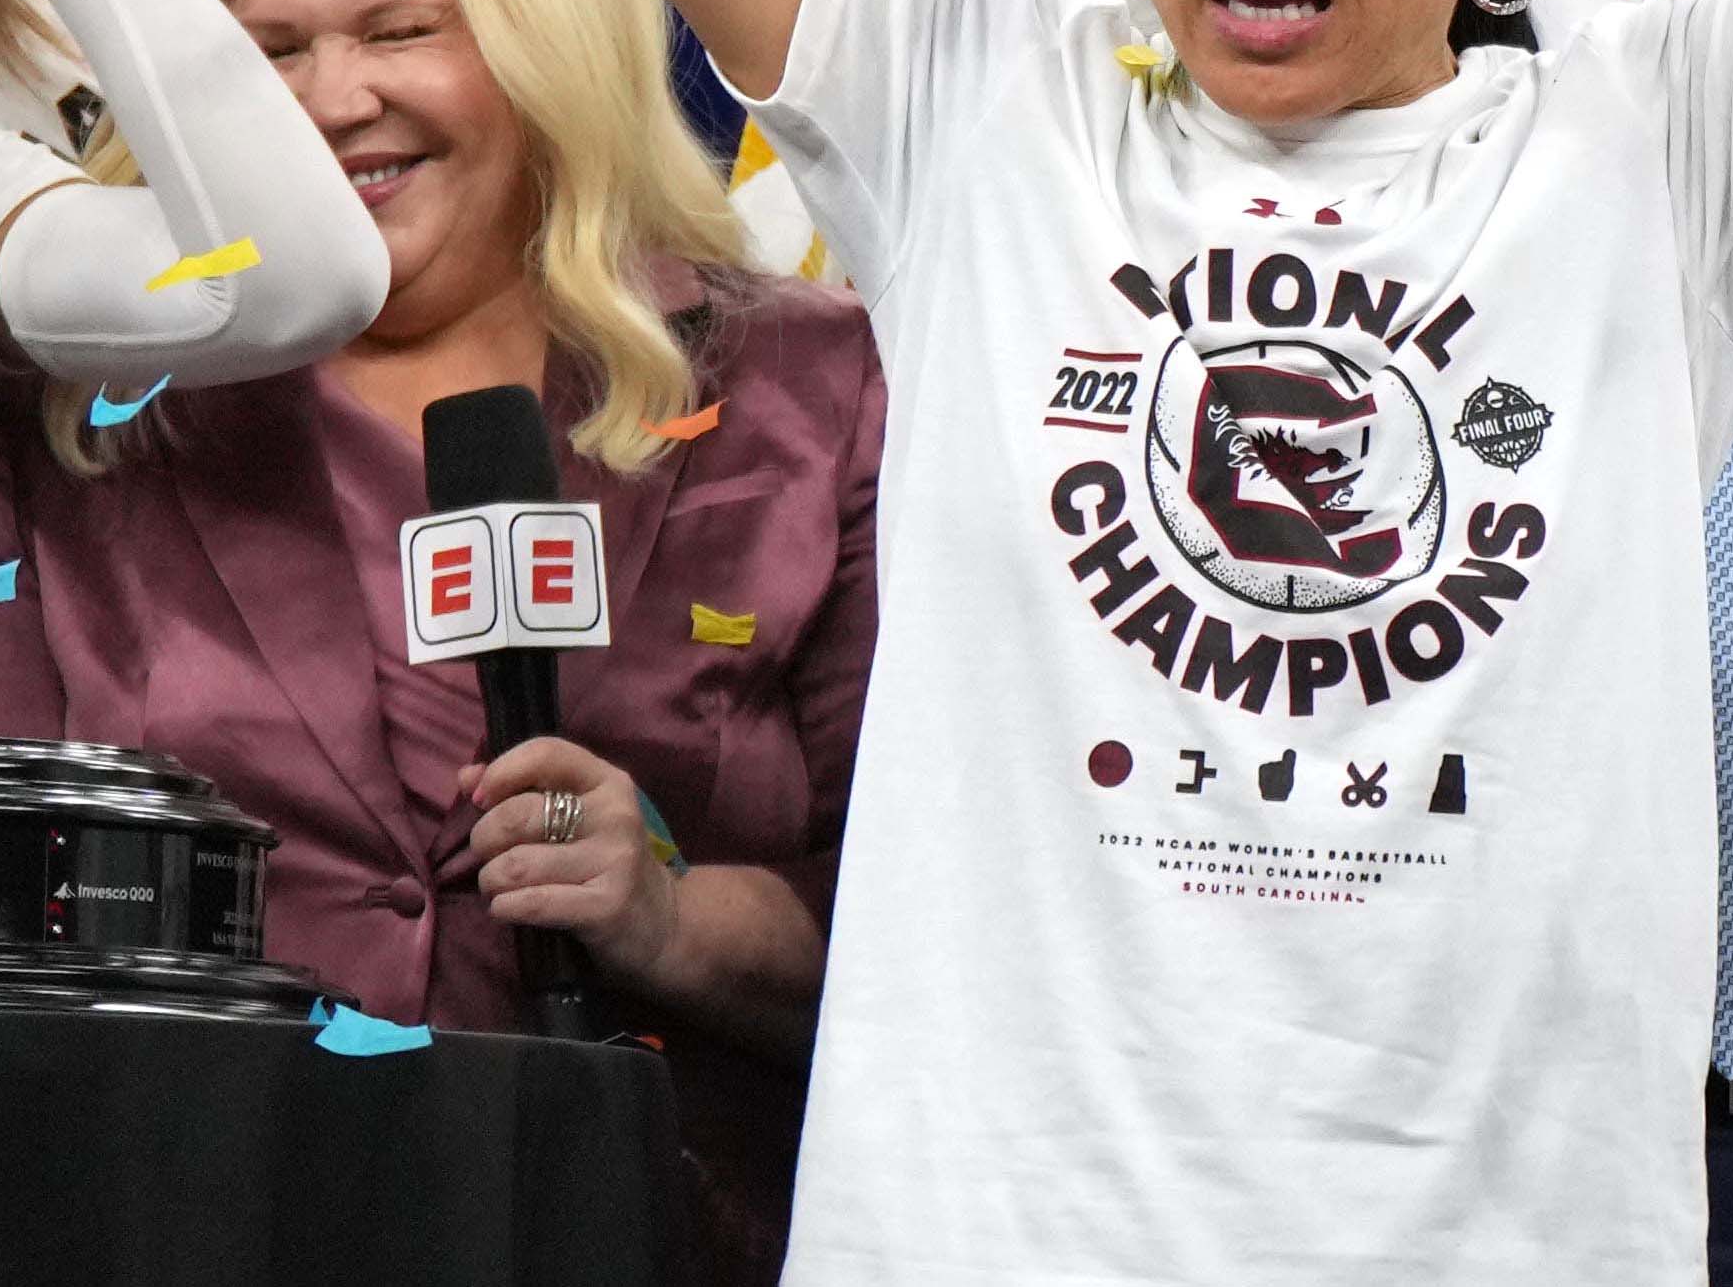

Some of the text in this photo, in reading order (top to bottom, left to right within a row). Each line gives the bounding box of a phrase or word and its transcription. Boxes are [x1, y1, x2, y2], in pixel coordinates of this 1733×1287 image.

[1048, 366, 1139, 416] 2022
[1459, 409, 1546, 443] FINAL FOUR
[431, 539, 575, 617] E E
[1050, 459, 1549, 718] CHAMPIONS
[1098, 833, 1144, 847] 2022
[1228, 841, 1316, 860] WOMEN'S
[1328, 849, 1448, 866] BASKETBALL
[1158, 859, 1384, 885] NATIONAL CHAMPIONS
[77, 883, 127, 900] Invesco
[1182, 881, 1247, 897] SOUTH
